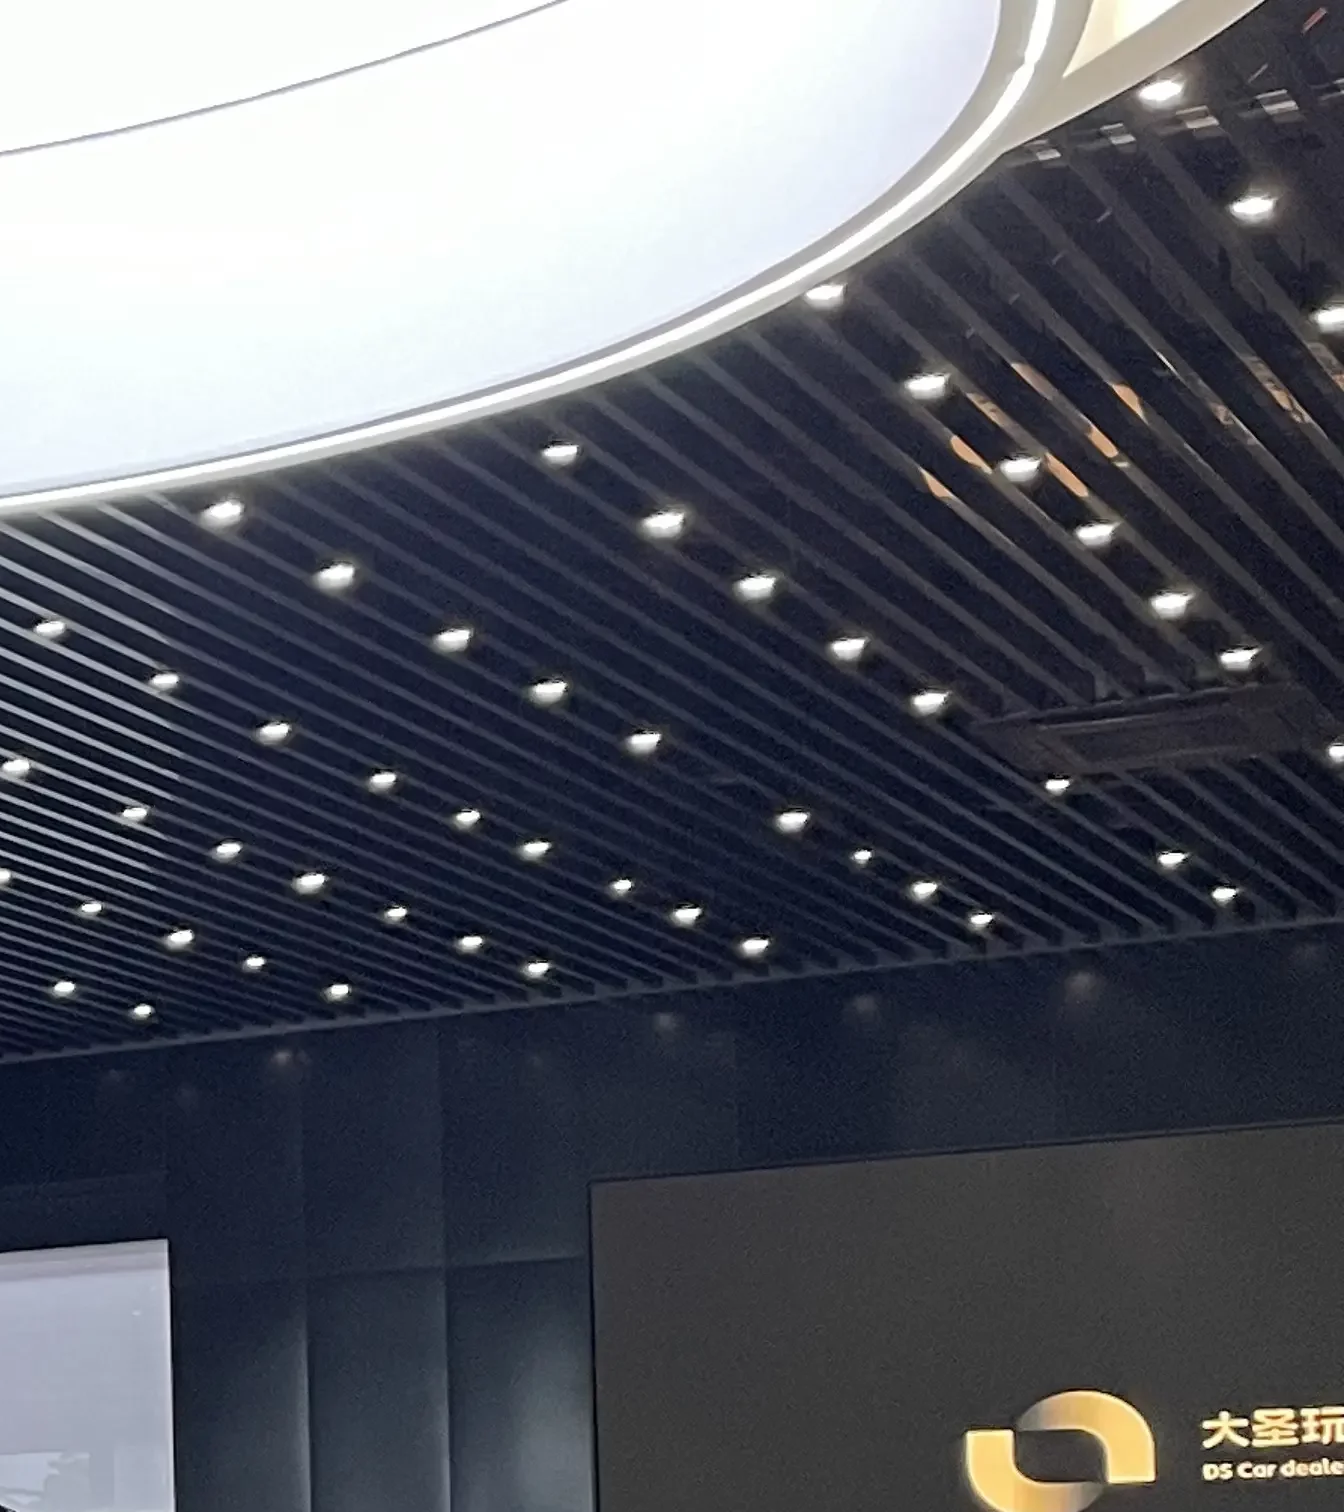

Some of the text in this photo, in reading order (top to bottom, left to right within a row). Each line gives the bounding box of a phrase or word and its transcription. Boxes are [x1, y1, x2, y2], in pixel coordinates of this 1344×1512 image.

[1201, 1406, 1344, 1448] 大圣玩
[1202, 1463, 1233, 1480] DS
[1237, 1461, 1277, 1479] Car
